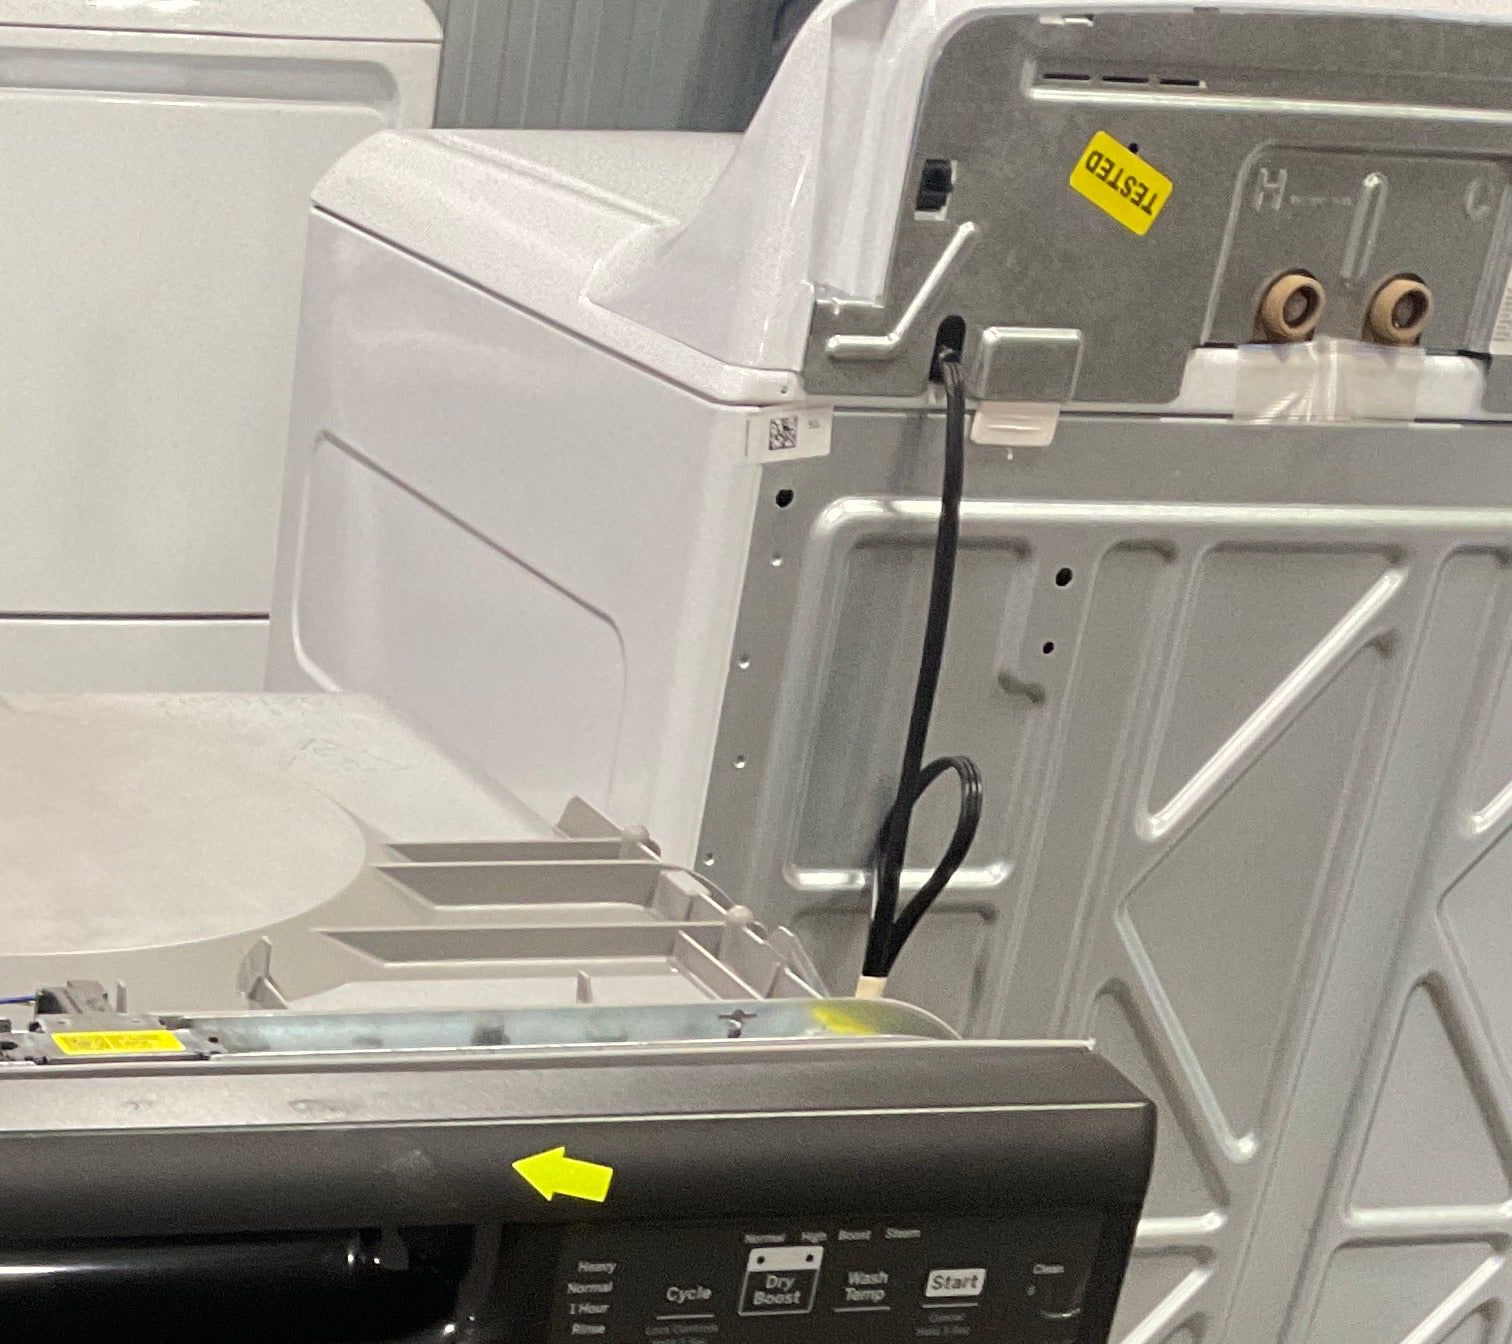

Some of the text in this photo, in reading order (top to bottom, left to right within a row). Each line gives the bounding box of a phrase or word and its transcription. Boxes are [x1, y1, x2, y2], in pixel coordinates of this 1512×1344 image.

[1085, 150, 1158, 215] TESTED
[765, 1274, 796, 1291] Dry
[847, 1270, 889, 1285] Wash
[931, 1274, 979, 1290] Start
[666, 1284, 713, 1303] Cycle
[753, 1290, 801, 1305] Boost
[845, 1287, 885, 1302] Temp
